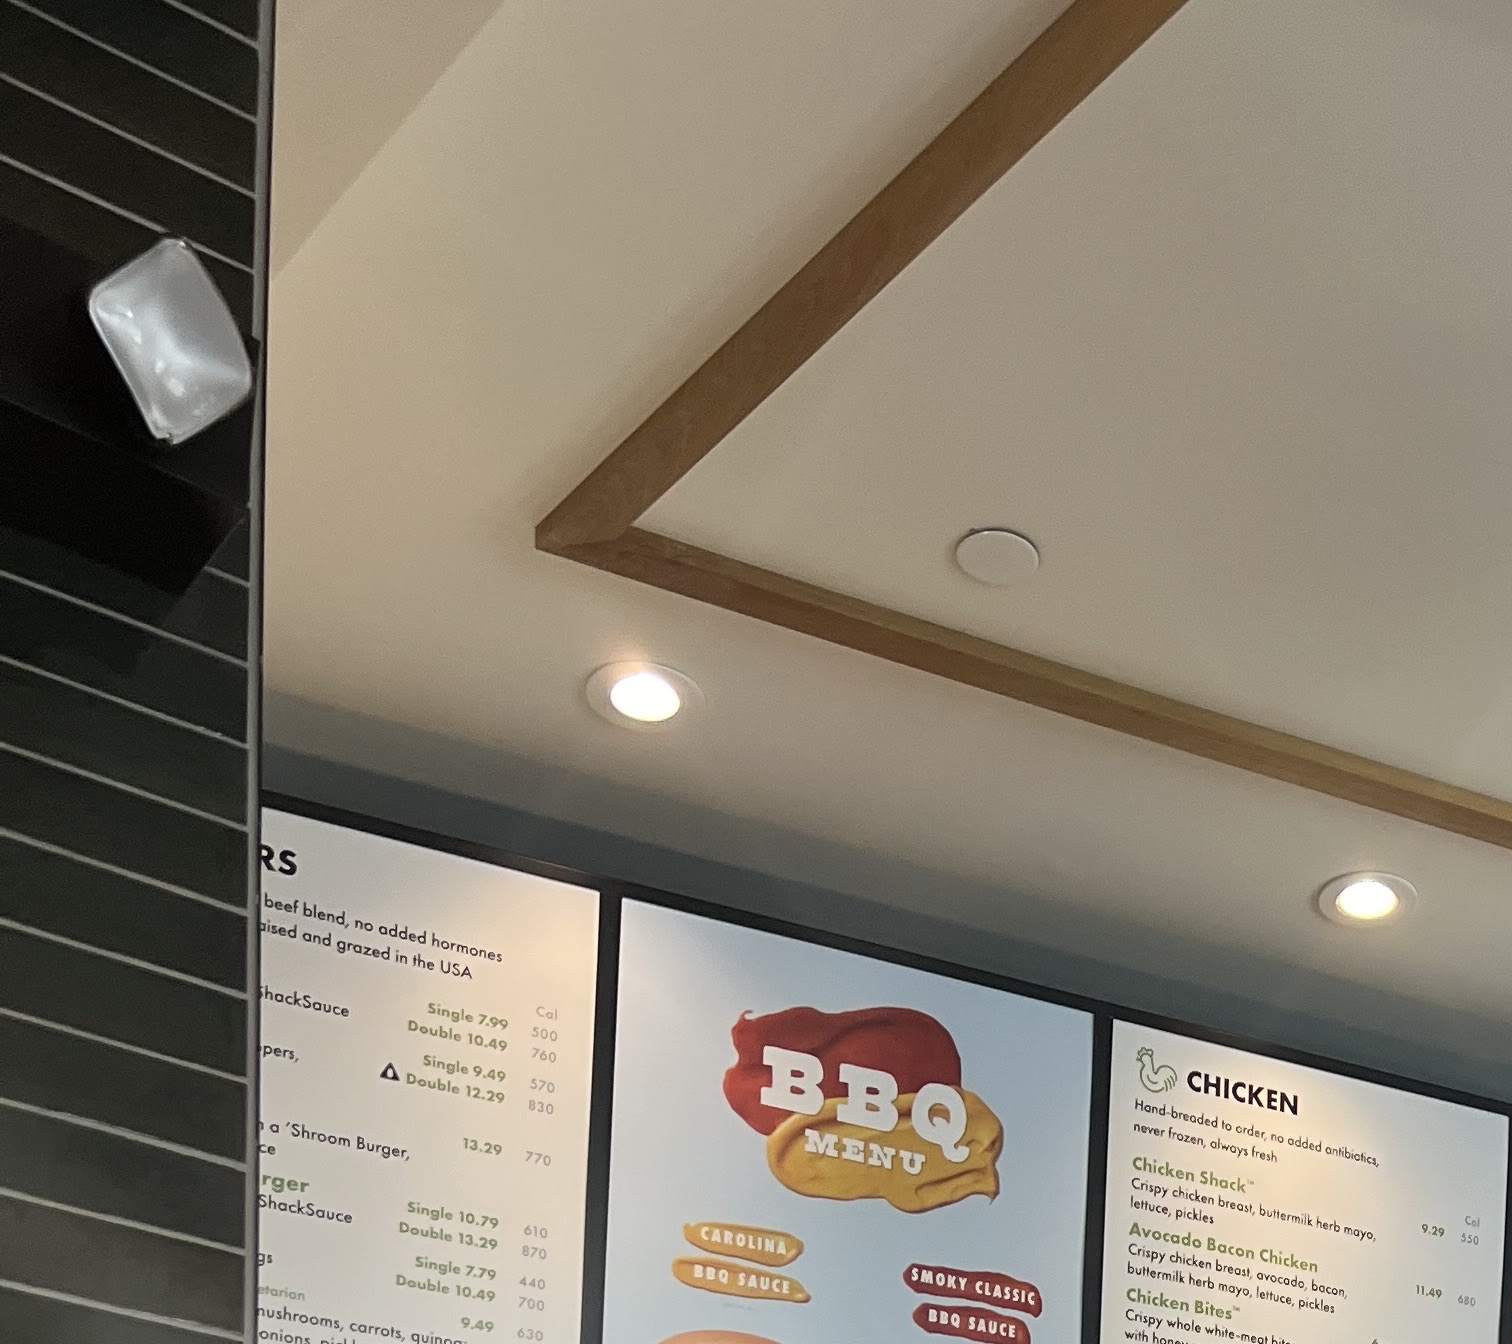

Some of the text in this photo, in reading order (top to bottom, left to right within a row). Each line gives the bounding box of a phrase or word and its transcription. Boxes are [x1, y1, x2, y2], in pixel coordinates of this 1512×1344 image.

[264, 893, 502, 962] beef blend, no added hormones
[407, 1019, 556, 1063] Double 10.49 760
[427, 1002, 557, 1041] Single 7.99 500
[758, 1043, 972, 1160] BBQ
[1186, 1070, 1298, 1116] CHICKEN
[268, 1123, 279, 1133] a
[355, 1135, 409, 1161] Burger,
[462, 1137, 551, 1166] 13.29 770
[804, 1129, 926, 1176] MENU
[1133, 1123, 1277, 1163] never frozen, always fresh
[1134, 1097, 1379, 1168] Hand-breaded to order, no added antibiotics,
[1130, 1194, 1214, 1224] lettuce, pickles
[699, 1226, 788, 1257] CAROLINA
[1128, 1221, 1201, 1248] Avocado
[1206, 1236, 1254, 1259] Bacon
[1259, 1248, 1317, 1273] Chicken
[1415, 1284, 1442, 1299] 11.49
[693, 1263, 791, 1296] BBQ SAUCE
[909, 1266, 1037, 1307] SMOKY CLASSIC
[927, 1308, 1017, 1340] BBQ SAUCE
